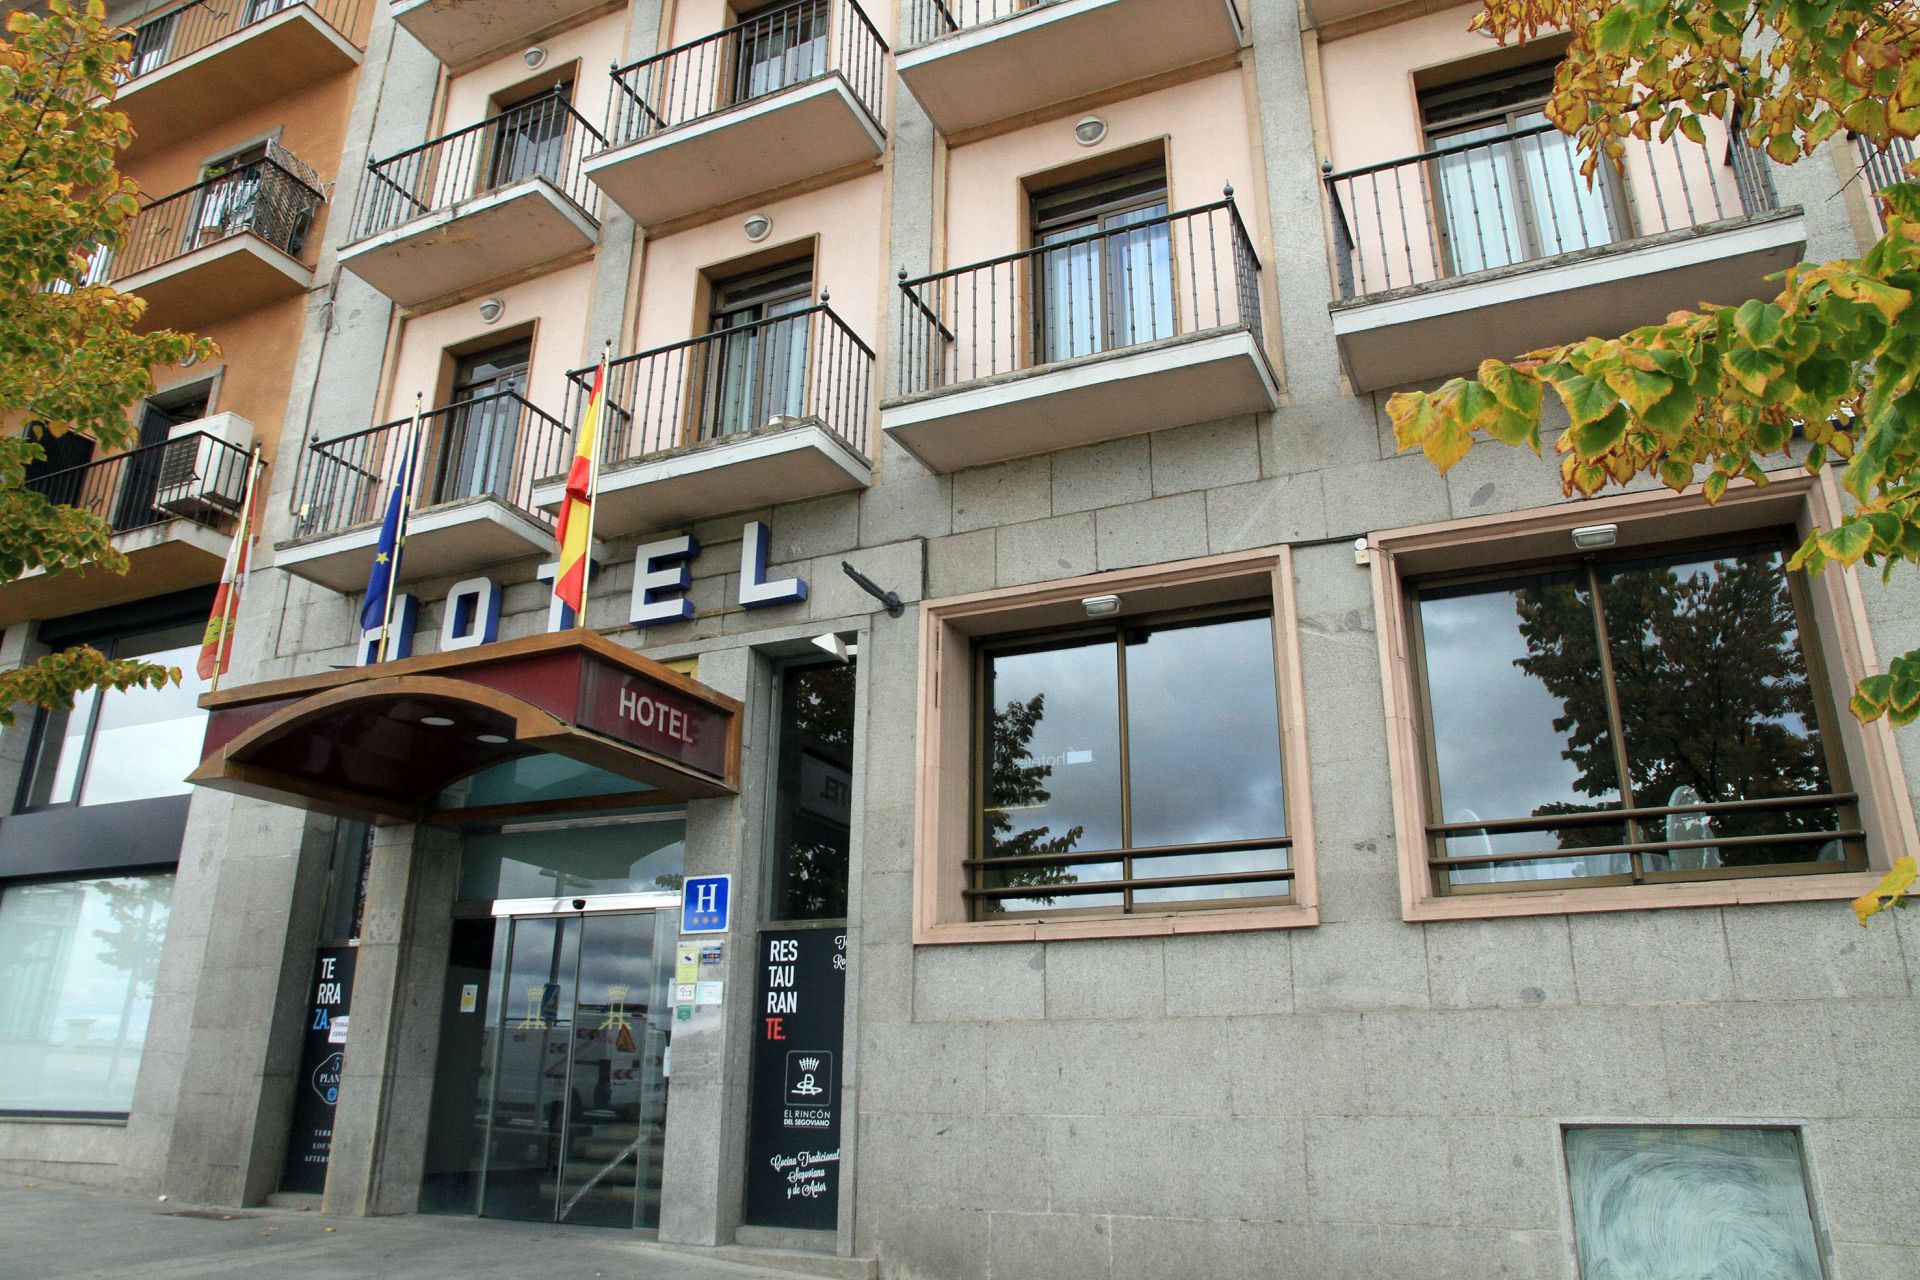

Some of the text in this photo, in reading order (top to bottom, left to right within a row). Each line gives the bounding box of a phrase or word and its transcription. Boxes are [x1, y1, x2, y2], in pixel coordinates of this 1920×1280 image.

[356, 521, 808, 667] HOTEL
[618, 687, 693, 744] HOTEL
[695, 884, 718, 913] H
[769, 940, 798, 962] RES
[321, 957, 337, 980] TE
[768, 965, 795, 988] TAU
[317, 982, 341, 1005] RRA
[767, 991, 797, 1014] RAN
[765, 1017, 787, 1040] TE.
[783, 1118, 830, 1127] DEL SEGOVIANO
[784, 1108, 831, 1119] EL RINCÓN
[770, 1148, 841, 1172] Cocina Tradicional
[787, 1166, 826, 1183] Segoviana
[787, 1180, 827, 1199] y de Autor
